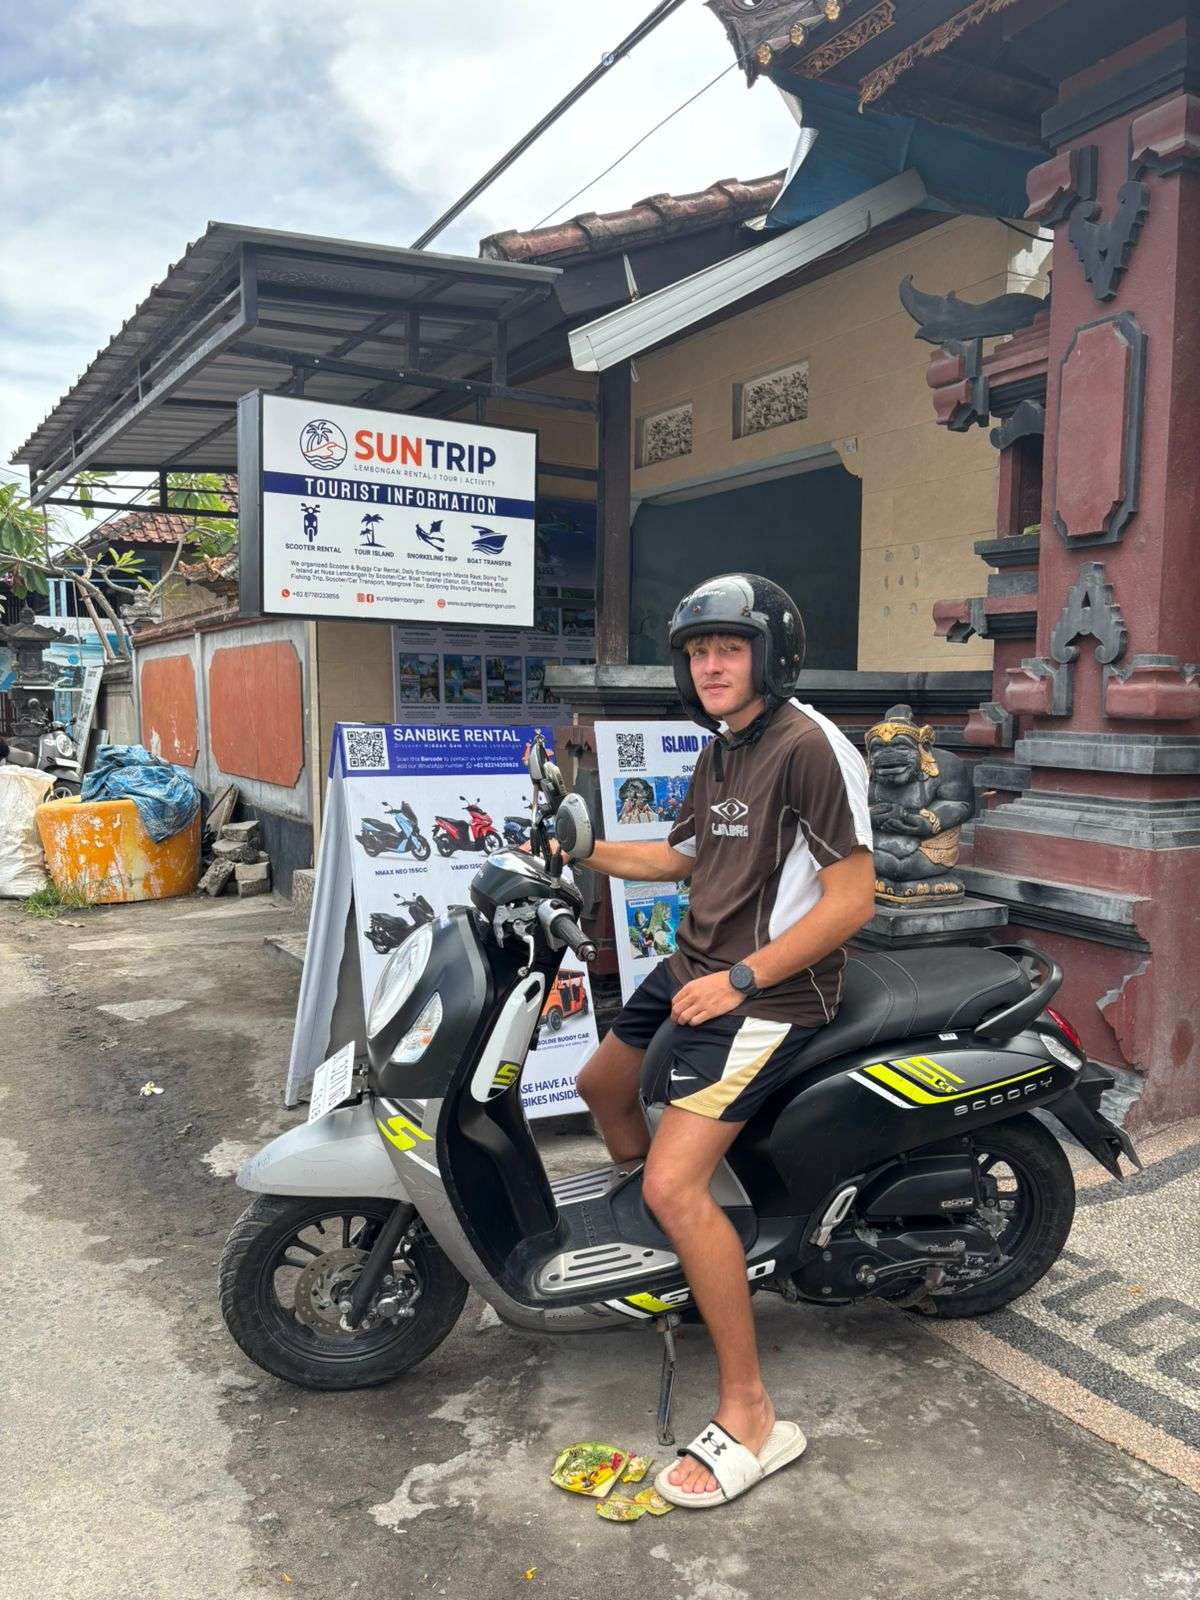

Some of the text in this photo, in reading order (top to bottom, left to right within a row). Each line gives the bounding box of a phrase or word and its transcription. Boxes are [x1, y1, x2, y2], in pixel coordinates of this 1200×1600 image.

[354, 430, 497, 474] SUNTRIP
[354, 465, 496, 487] LEMBONGAN RENTAL TOUR ACTIVITY
[305, 478, 496, 513] TOURIST INFORMATION
[285, 543, 342, 553] SCOOTER RENTAL
[354, 548, 394, 558] TOUR ISLAND
[407, 553, 443, 561] SNORKELING
[483, 559, 512, 567] TRANSFER
[329, 562, 350, 570] Scooter
[356, 564, 372, 573] Buggy
[393, 728, 520, 742] SANBIKE RENTAL
[661, 735, 698, 752] ISLAND
[408, 867, 428, 875] 155CC
[535, 1079, 560, 1091] HAVE
[561, 1078, 568, 1086] A
[521, 1089, 579, 1108] BIKES INSIDE
[954, 1076, 1053, 1116] SCOOPY
